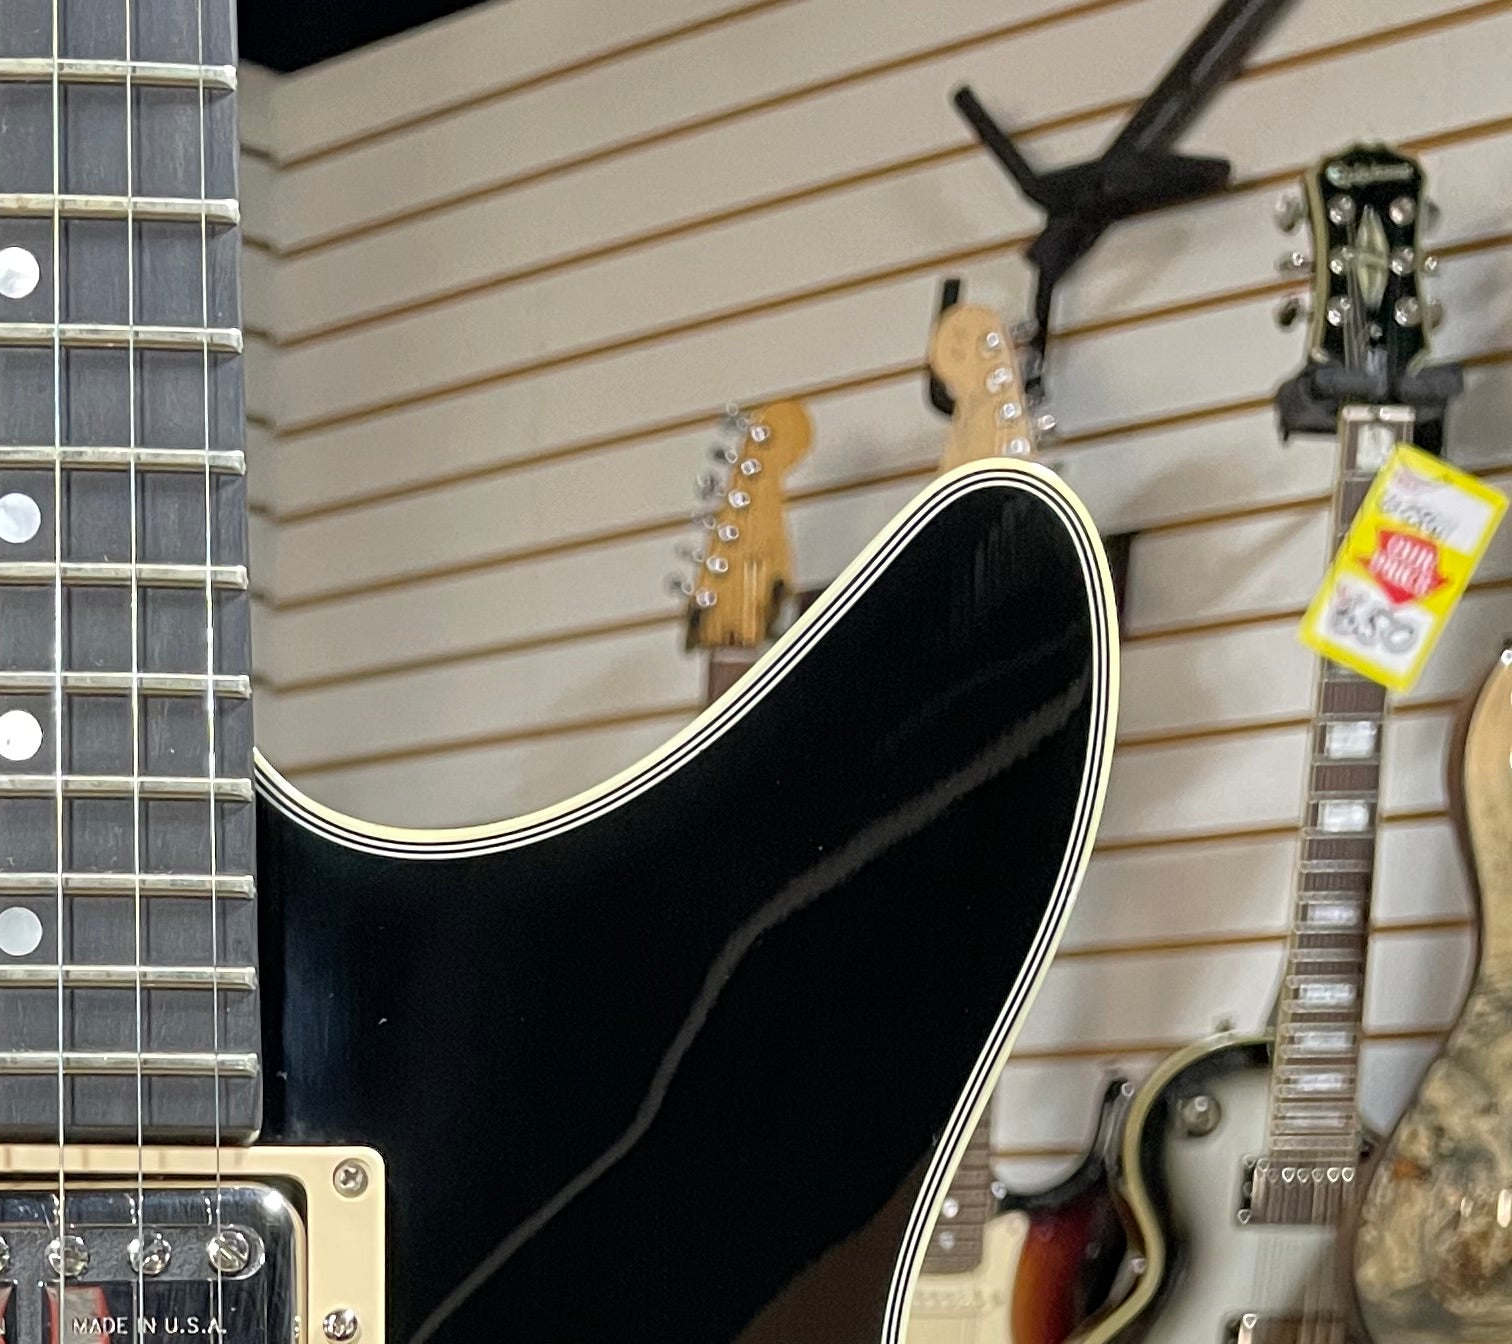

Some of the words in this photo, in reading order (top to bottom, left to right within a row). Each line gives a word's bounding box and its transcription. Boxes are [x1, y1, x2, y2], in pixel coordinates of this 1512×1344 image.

[1387, 535, 1438, 569] OUR
[73, 1316, 129, 1335] MADE
[164, 1315, 228, 1335] U.S.A.
